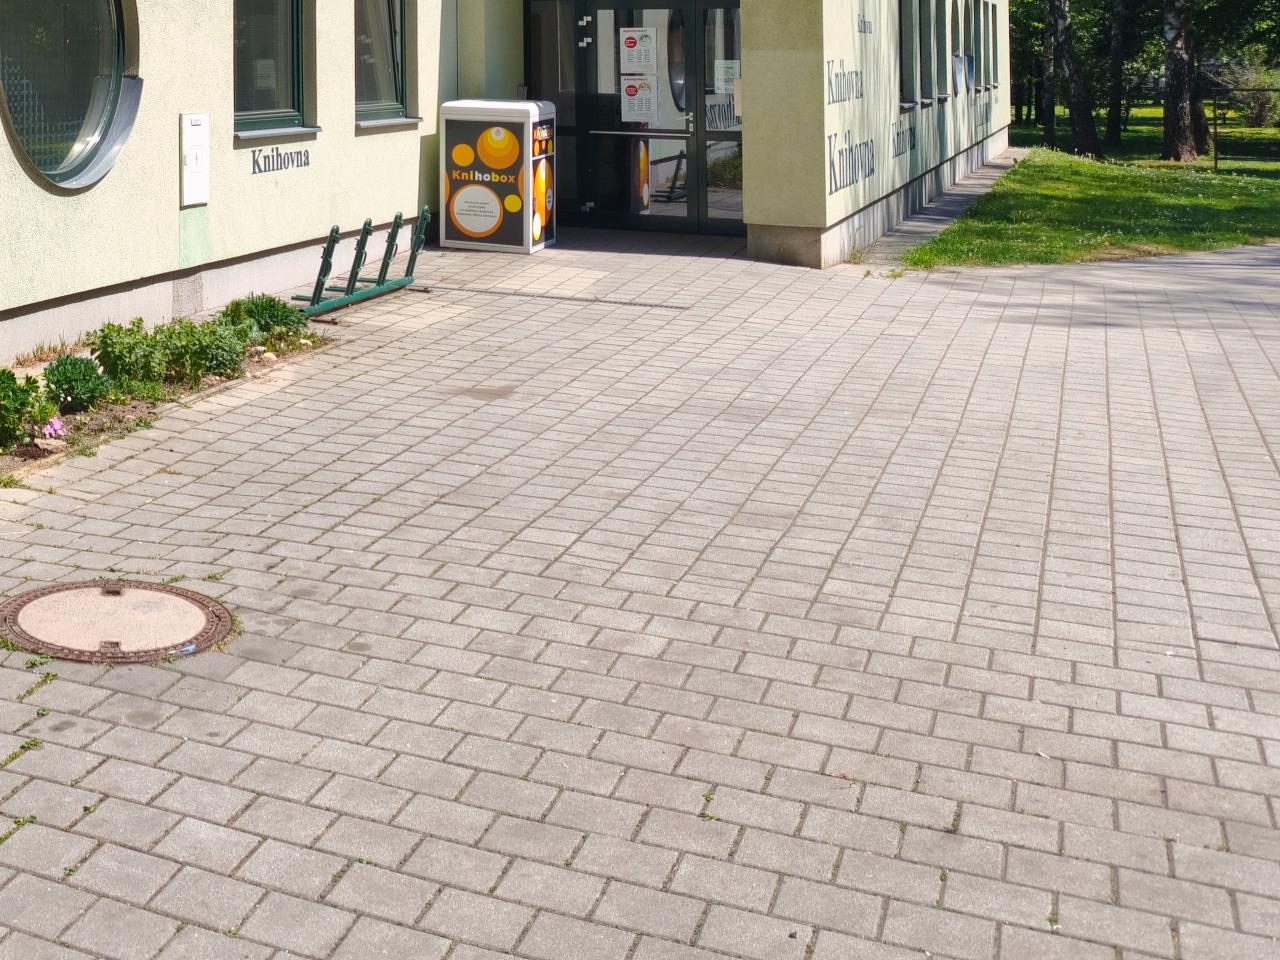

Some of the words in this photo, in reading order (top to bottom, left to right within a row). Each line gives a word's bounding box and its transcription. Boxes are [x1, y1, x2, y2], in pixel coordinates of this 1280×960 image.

[827, 59, 864, 106] Knihovna
[251, 146, 311, 175] Knihovna
[452, 169, 516, 184] Knihobox
[827, 129, 876, 196] Knihovna
